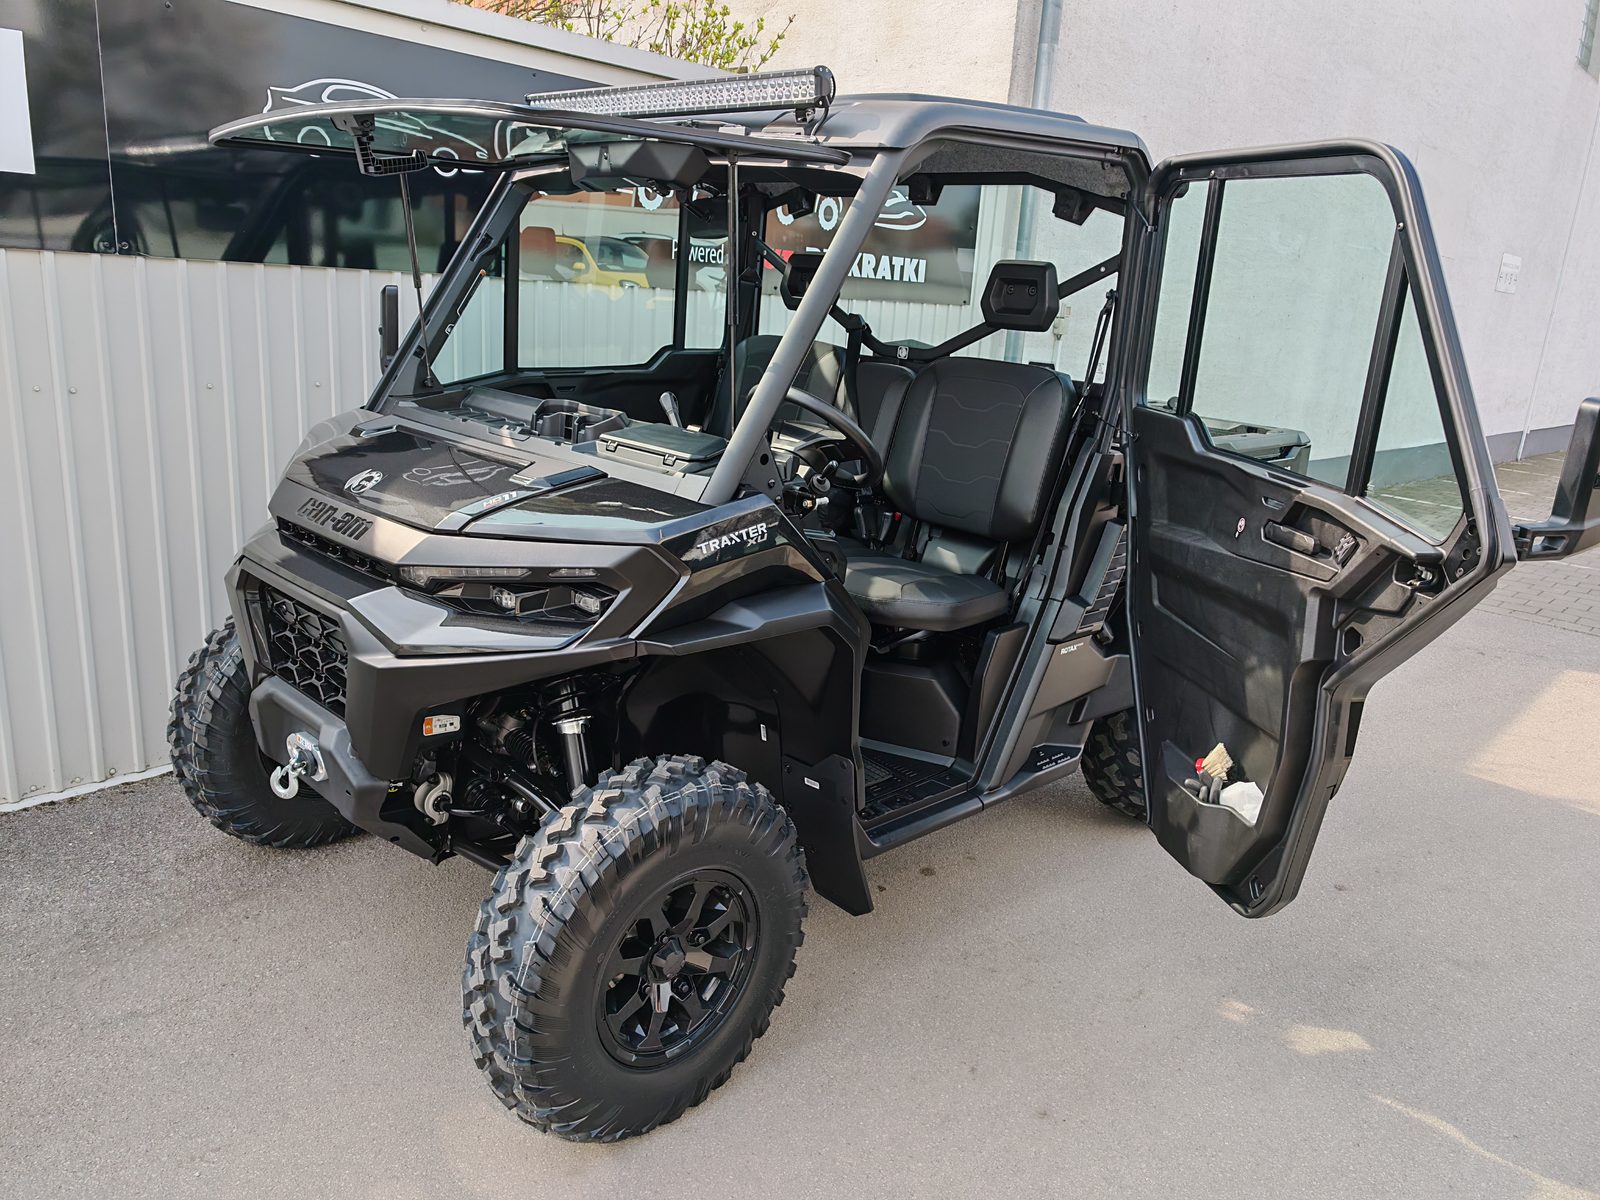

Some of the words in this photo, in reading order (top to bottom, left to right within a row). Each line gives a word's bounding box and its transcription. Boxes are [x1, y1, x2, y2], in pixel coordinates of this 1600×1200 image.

[671, 239, 724, 264] Pwered
[697, 522, 768, 554] TRAXTER
[746, 533, 768, 547] XU
